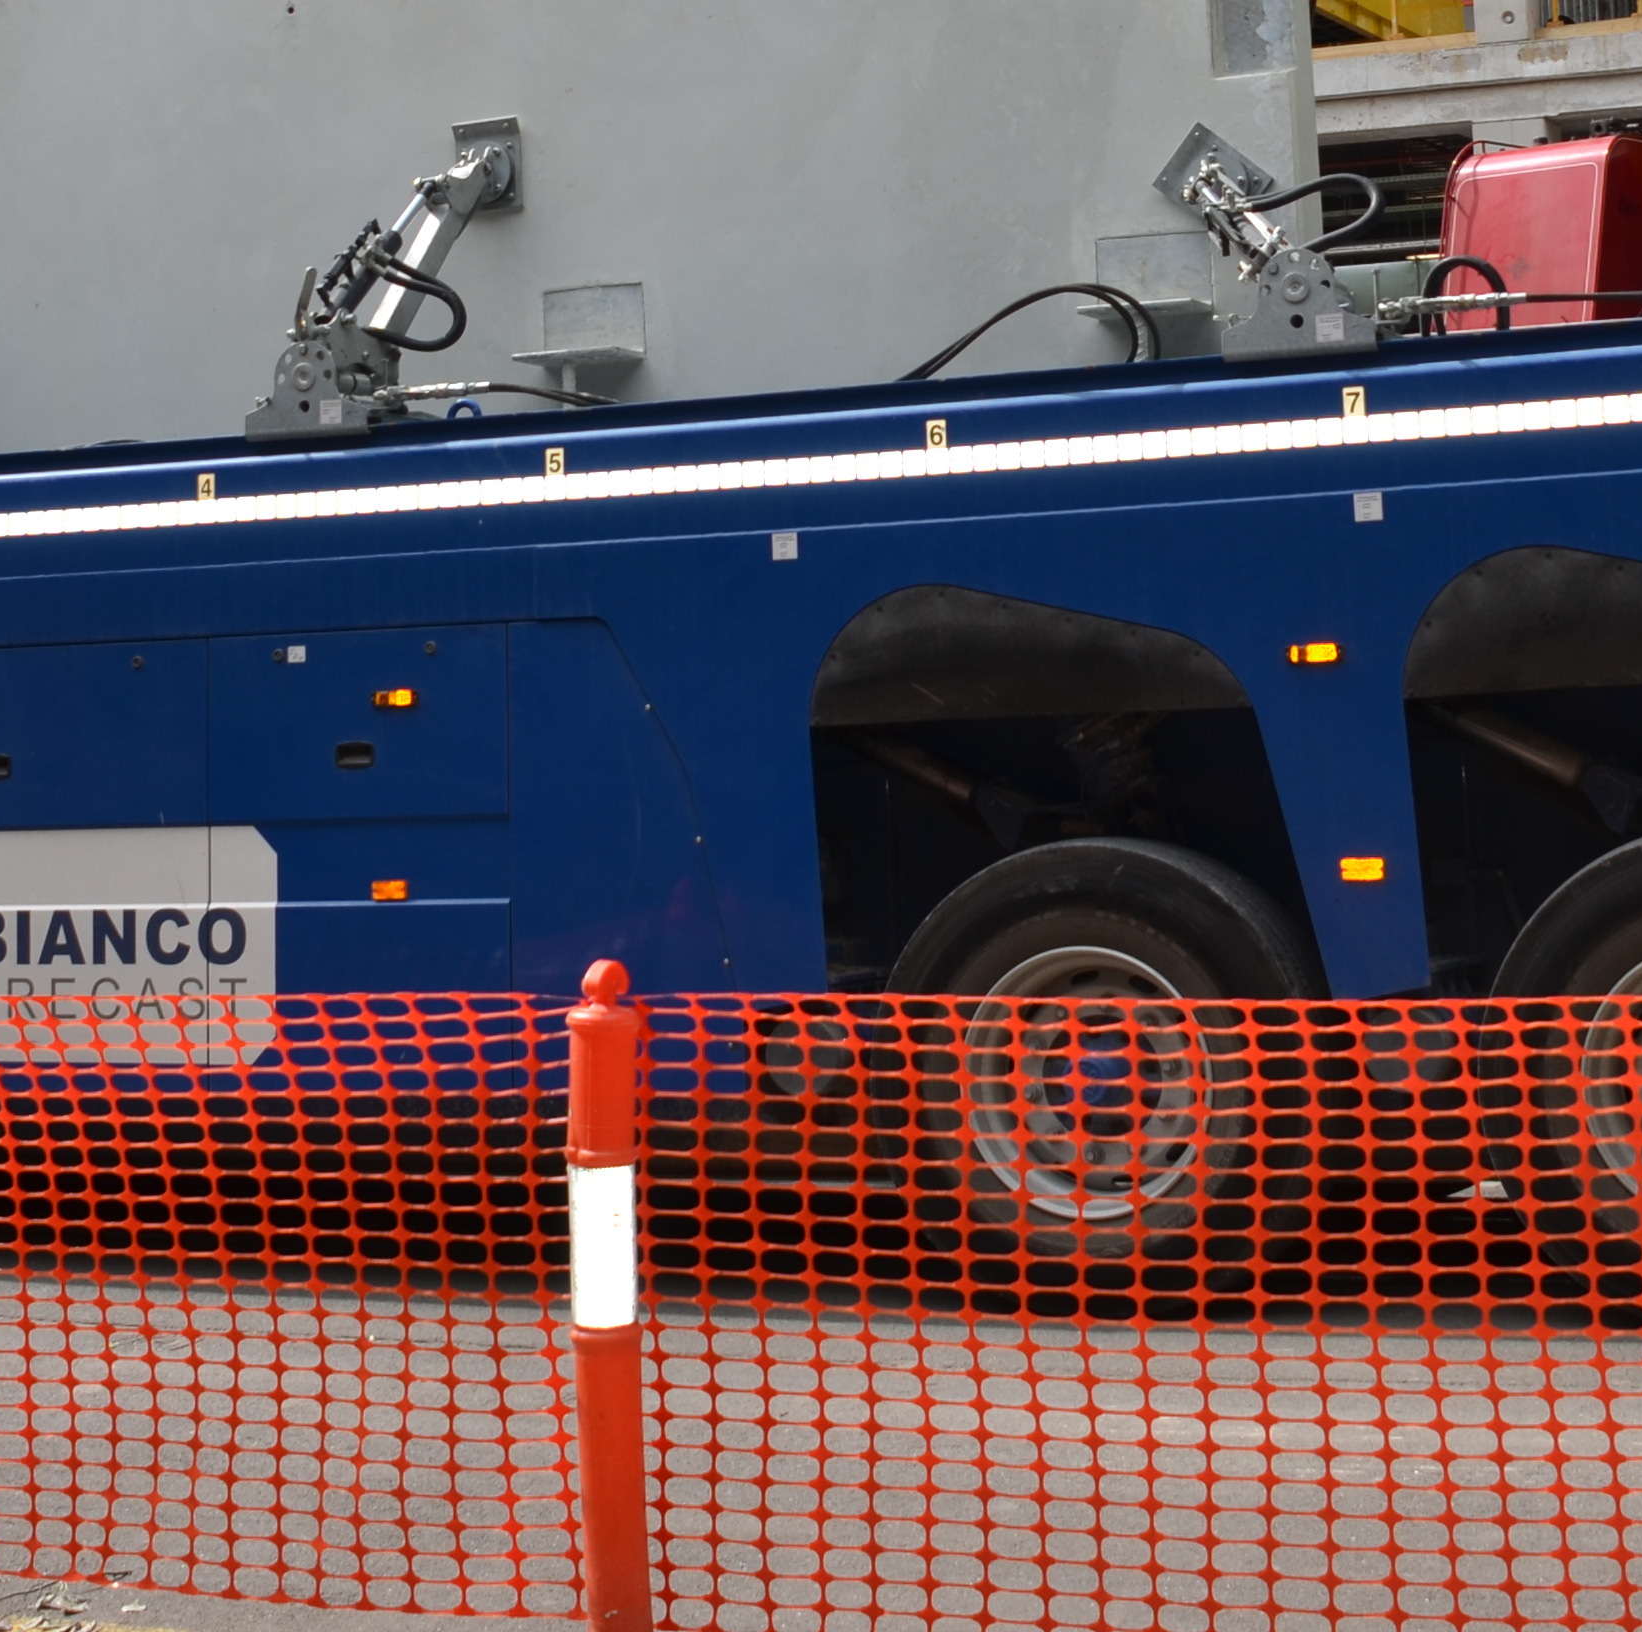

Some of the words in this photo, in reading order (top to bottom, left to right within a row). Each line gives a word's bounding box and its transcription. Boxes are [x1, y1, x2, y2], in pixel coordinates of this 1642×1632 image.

[1345, 392, 1360, 414] 7
[929, 424, 944, 446] 6
[549, 452, 561, 473] 5
[201, 478, 212, 498] 4
